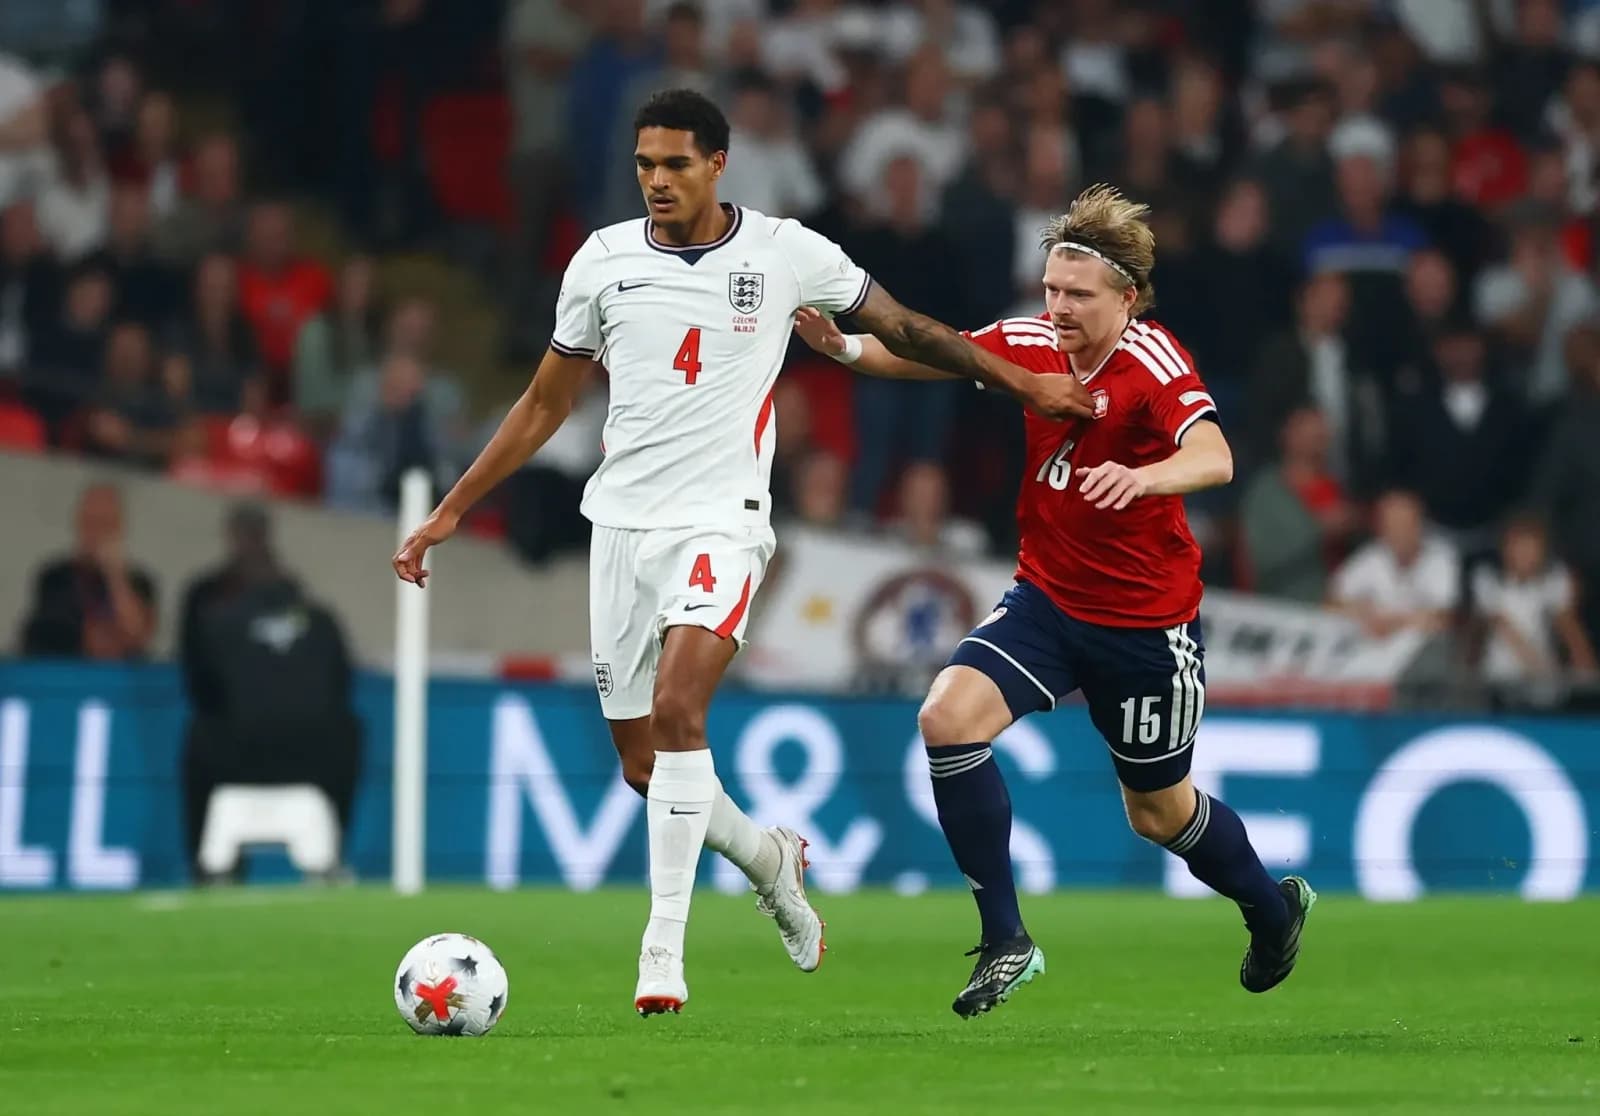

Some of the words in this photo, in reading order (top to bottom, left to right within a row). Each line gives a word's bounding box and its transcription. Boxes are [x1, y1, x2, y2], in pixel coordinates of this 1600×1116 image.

[673, 327, 702, 385] 4
[689, 553, 717, 593] 4
[1120, 696, 1162, 744] 15
